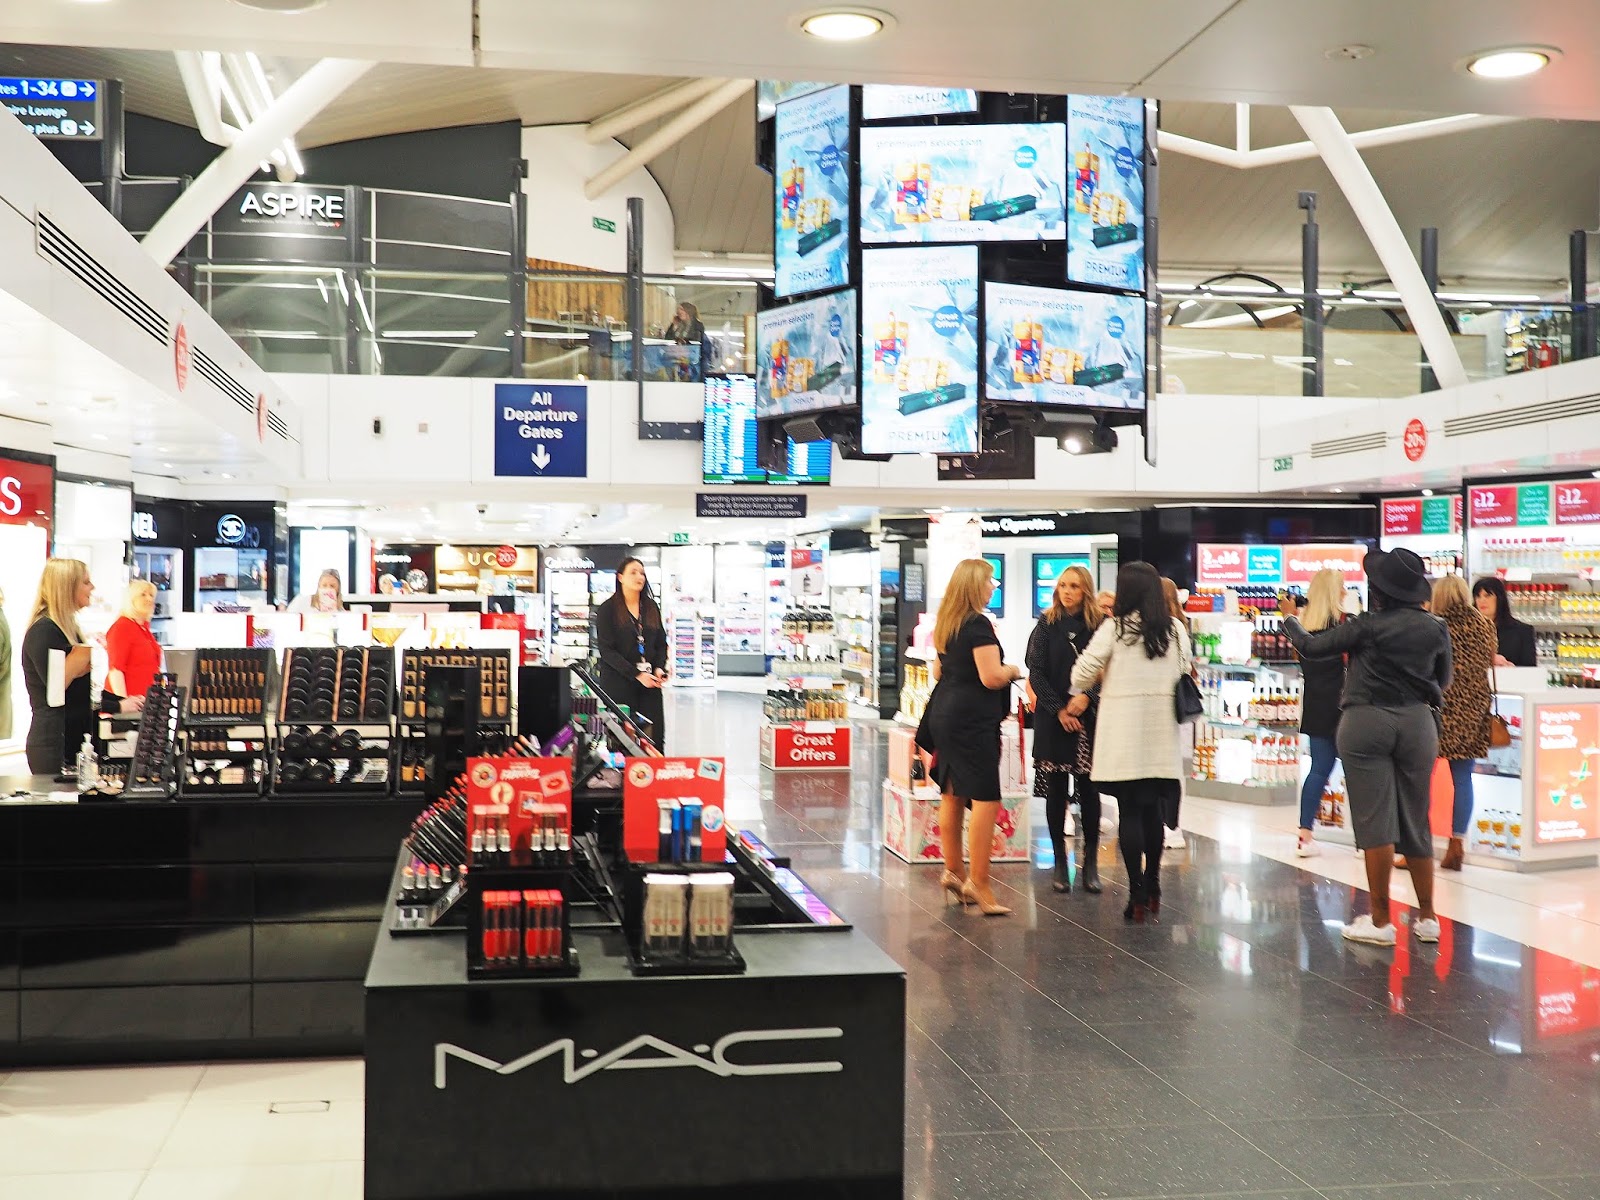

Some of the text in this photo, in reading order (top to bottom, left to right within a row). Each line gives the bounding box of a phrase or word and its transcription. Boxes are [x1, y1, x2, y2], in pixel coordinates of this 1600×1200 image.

[20, 80, 59, 97] 1-34
[28, 104, 68, 119] Lounge
[240, 191, 344, 218] ASPIRE
[531, 391, 552, 405] All
[503, 407, 578, 424] Departure
[518, 424, 563, 439] Gates
[0, 476, 22, 516] S
[1000, 518, 1056, 534] Cigarettes
[1288, 558, 1323, 572] Great
[792, 733, 834, 746] Great
[789, 748, 837, 761] Offers
